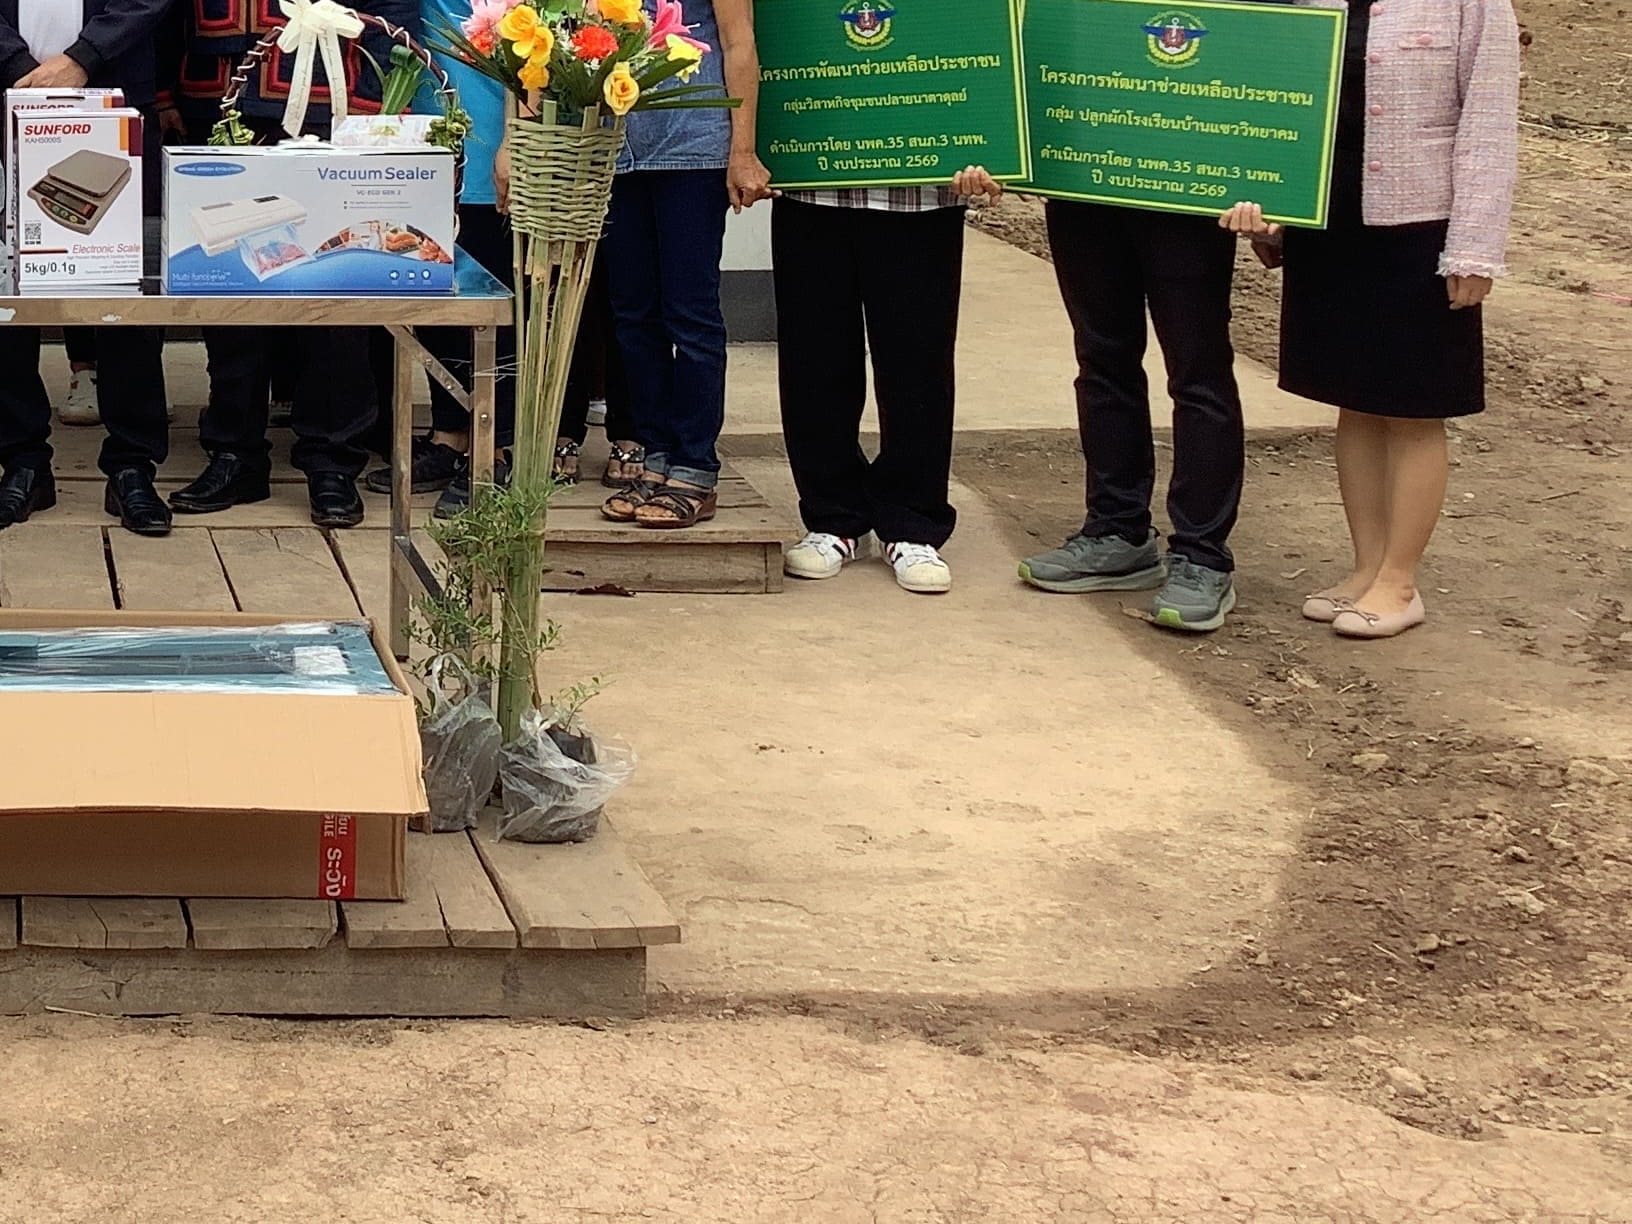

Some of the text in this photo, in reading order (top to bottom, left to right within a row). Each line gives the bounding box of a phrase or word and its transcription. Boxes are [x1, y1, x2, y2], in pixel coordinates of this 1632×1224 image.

[1039, 65, 1313, 106] โครงการพัฒนาช่วยเหลือประชาชน
[1046, 105, 1074, 123] กลุ่ม
[24, 124, 92, 136] SUNFORD
[770, 133, 988, 154] ดำเนินการโดย นพค.35 สนภ.3 นทพ.
[832, 156, 901, 170] งบประมาณ
[905, 154, 939, 167] 2569
[1040, 144, 1285, 185] ดำเนินการโดย นพค.35 สนภ.3 นทพ.
[317, 166, 437, 181] Vacuum Sealer
[1108, 173, 1184, 194] งบประมาณ
[1190, 182, 1227, 198] 2569
[72, 242, 141, 255] Electronic Scale
[24, 262, 77, 276] 5kg/0.1g
